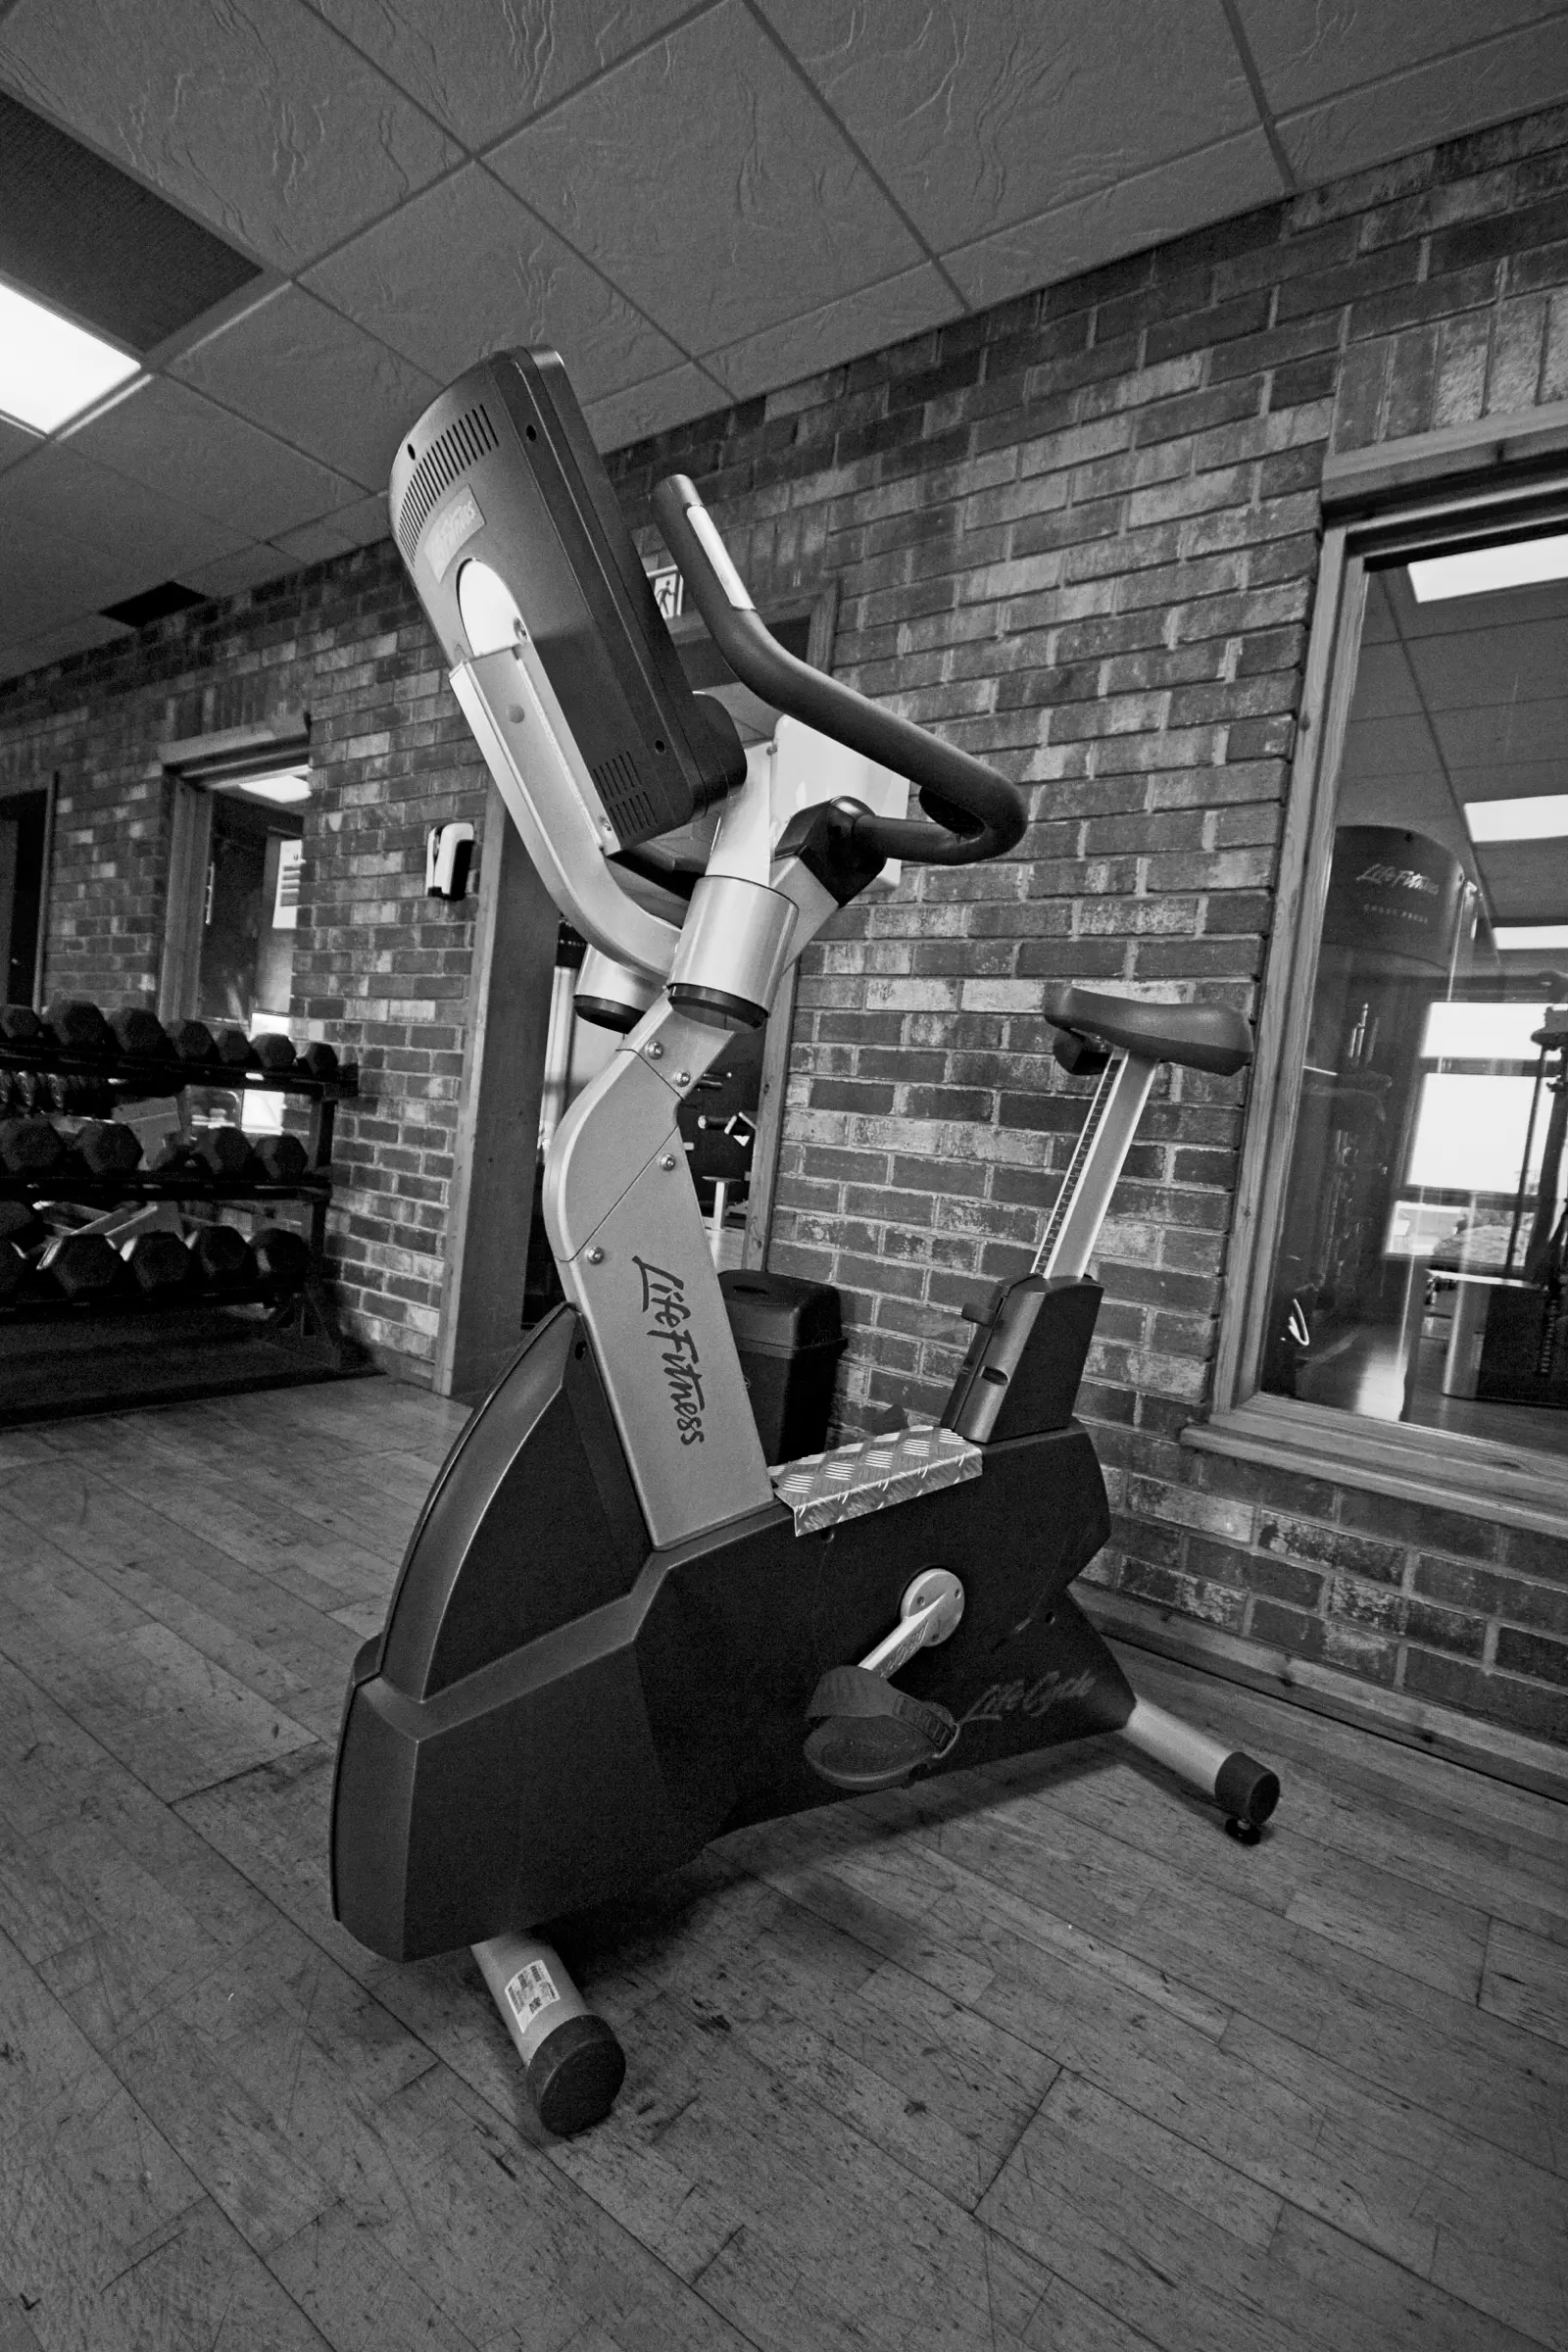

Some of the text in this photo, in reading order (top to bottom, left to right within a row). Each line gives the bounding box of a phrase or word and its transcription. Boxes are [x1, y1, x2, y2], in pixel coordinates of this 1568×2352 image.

[1355, 862, 1396, 885] Life
[631, 1255, 705, 1446] Life Fitness
